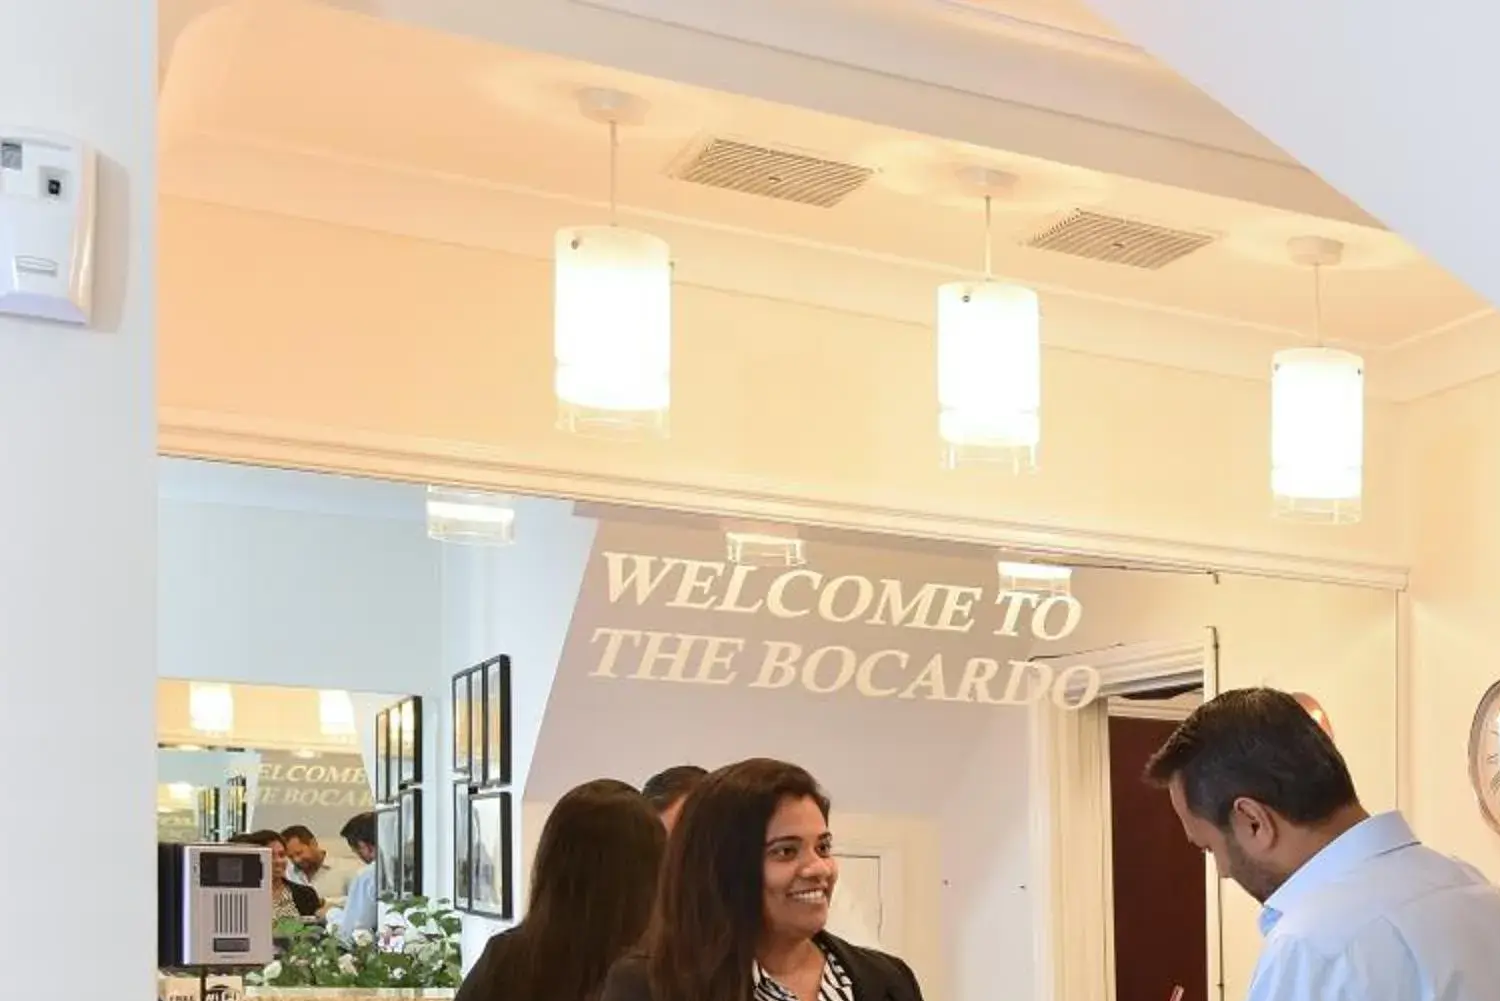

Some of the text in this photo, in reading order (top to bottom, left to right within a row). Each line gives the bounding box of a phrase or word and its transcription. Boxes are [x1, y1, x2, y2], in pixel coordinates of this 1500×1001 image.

[602, 550, 1084, 642] WELCOME TO
[590, 627, 1101, 712] THE BOCARDO
[258, 763, 365, 784] ELCOME
